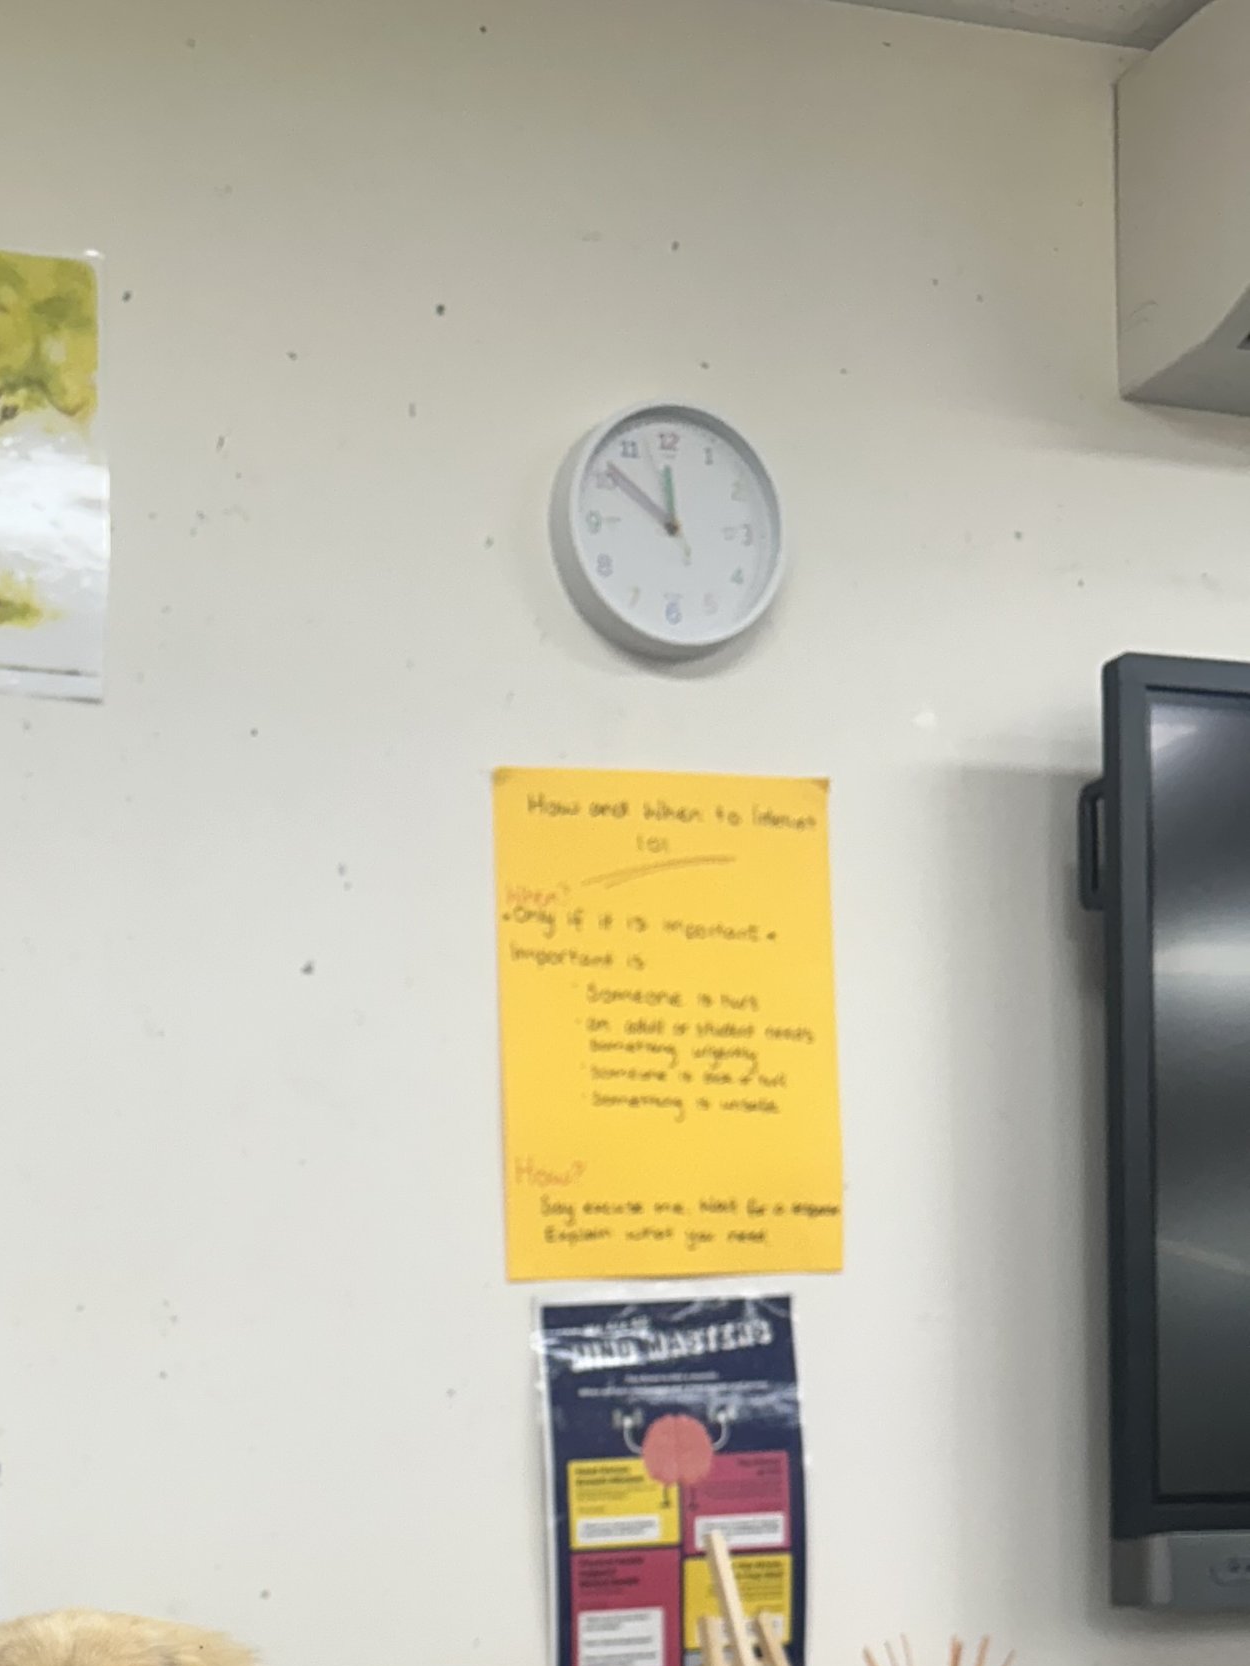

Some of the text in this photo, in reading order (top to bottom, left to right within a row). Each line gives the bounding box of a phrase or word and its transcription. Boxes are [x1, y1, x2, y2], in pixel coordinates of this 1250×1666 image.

[658, 432, 679, 450] 12
[666, 602, 681, 625] 6
[527, 793, 580, 816] How
[589, 800, 629, 818] and
[715, 804, 741, 825] to
[568, 907, 585, 931] if
[599, 912, 613, 929] it
[627, 915, 648, 932] is
[626, 953, 646, 970] is
[697, 993, 713, 1008] is
